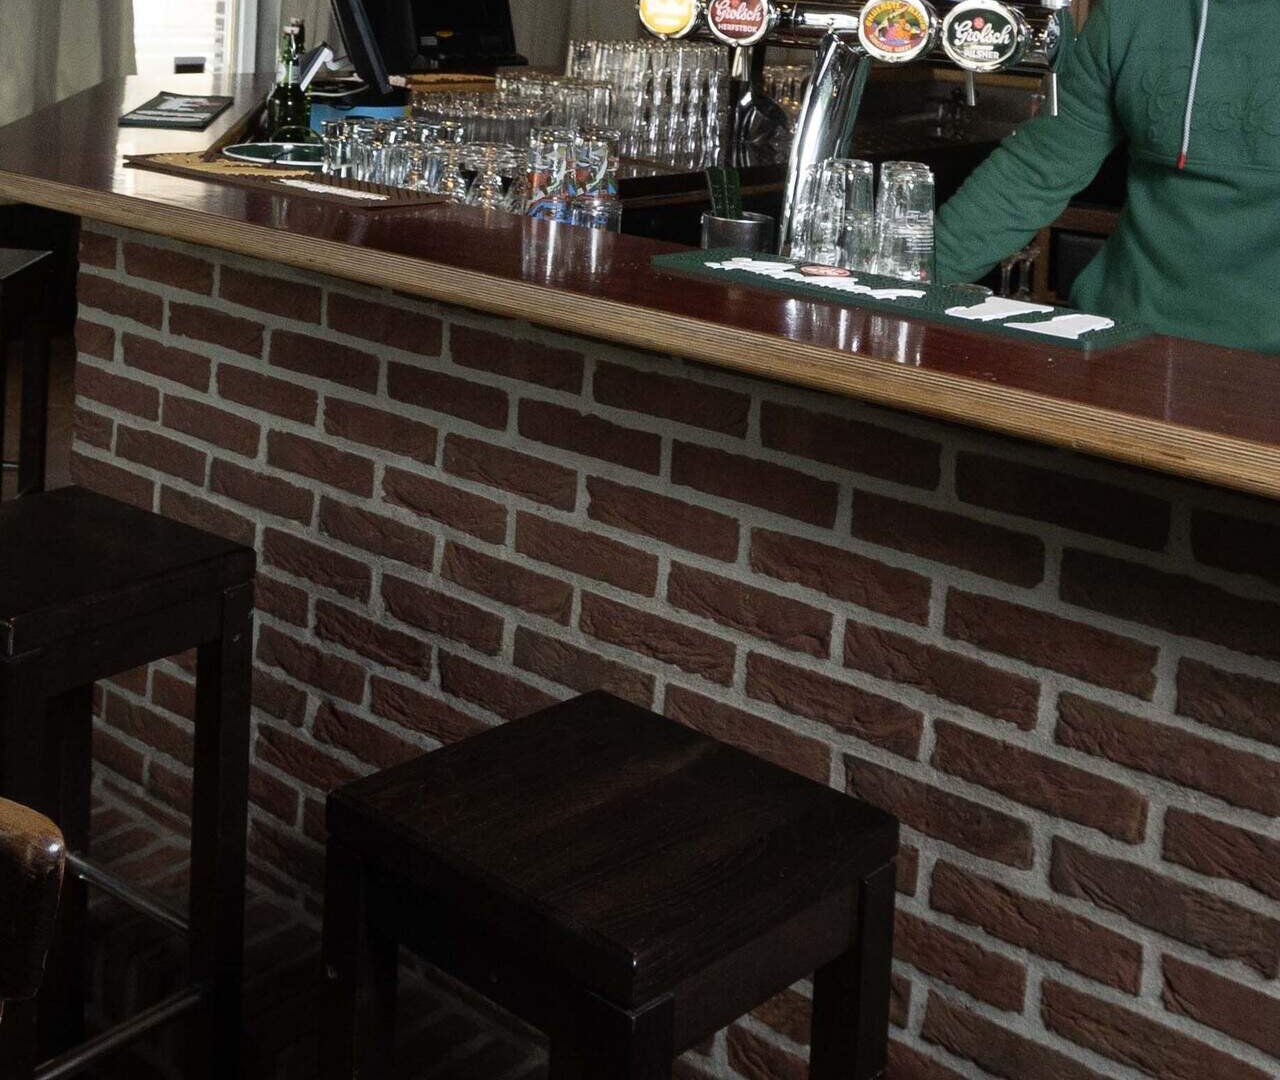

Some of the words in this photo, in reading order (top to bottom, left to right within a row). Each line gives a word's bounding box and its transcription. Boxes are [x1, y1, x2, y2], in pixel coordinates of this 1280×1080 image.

[715, 0, 763, 23] Grolsch
[954, 20, 1013, 45] Grolsch
[964, 49, 1000, 59] PILSNER
